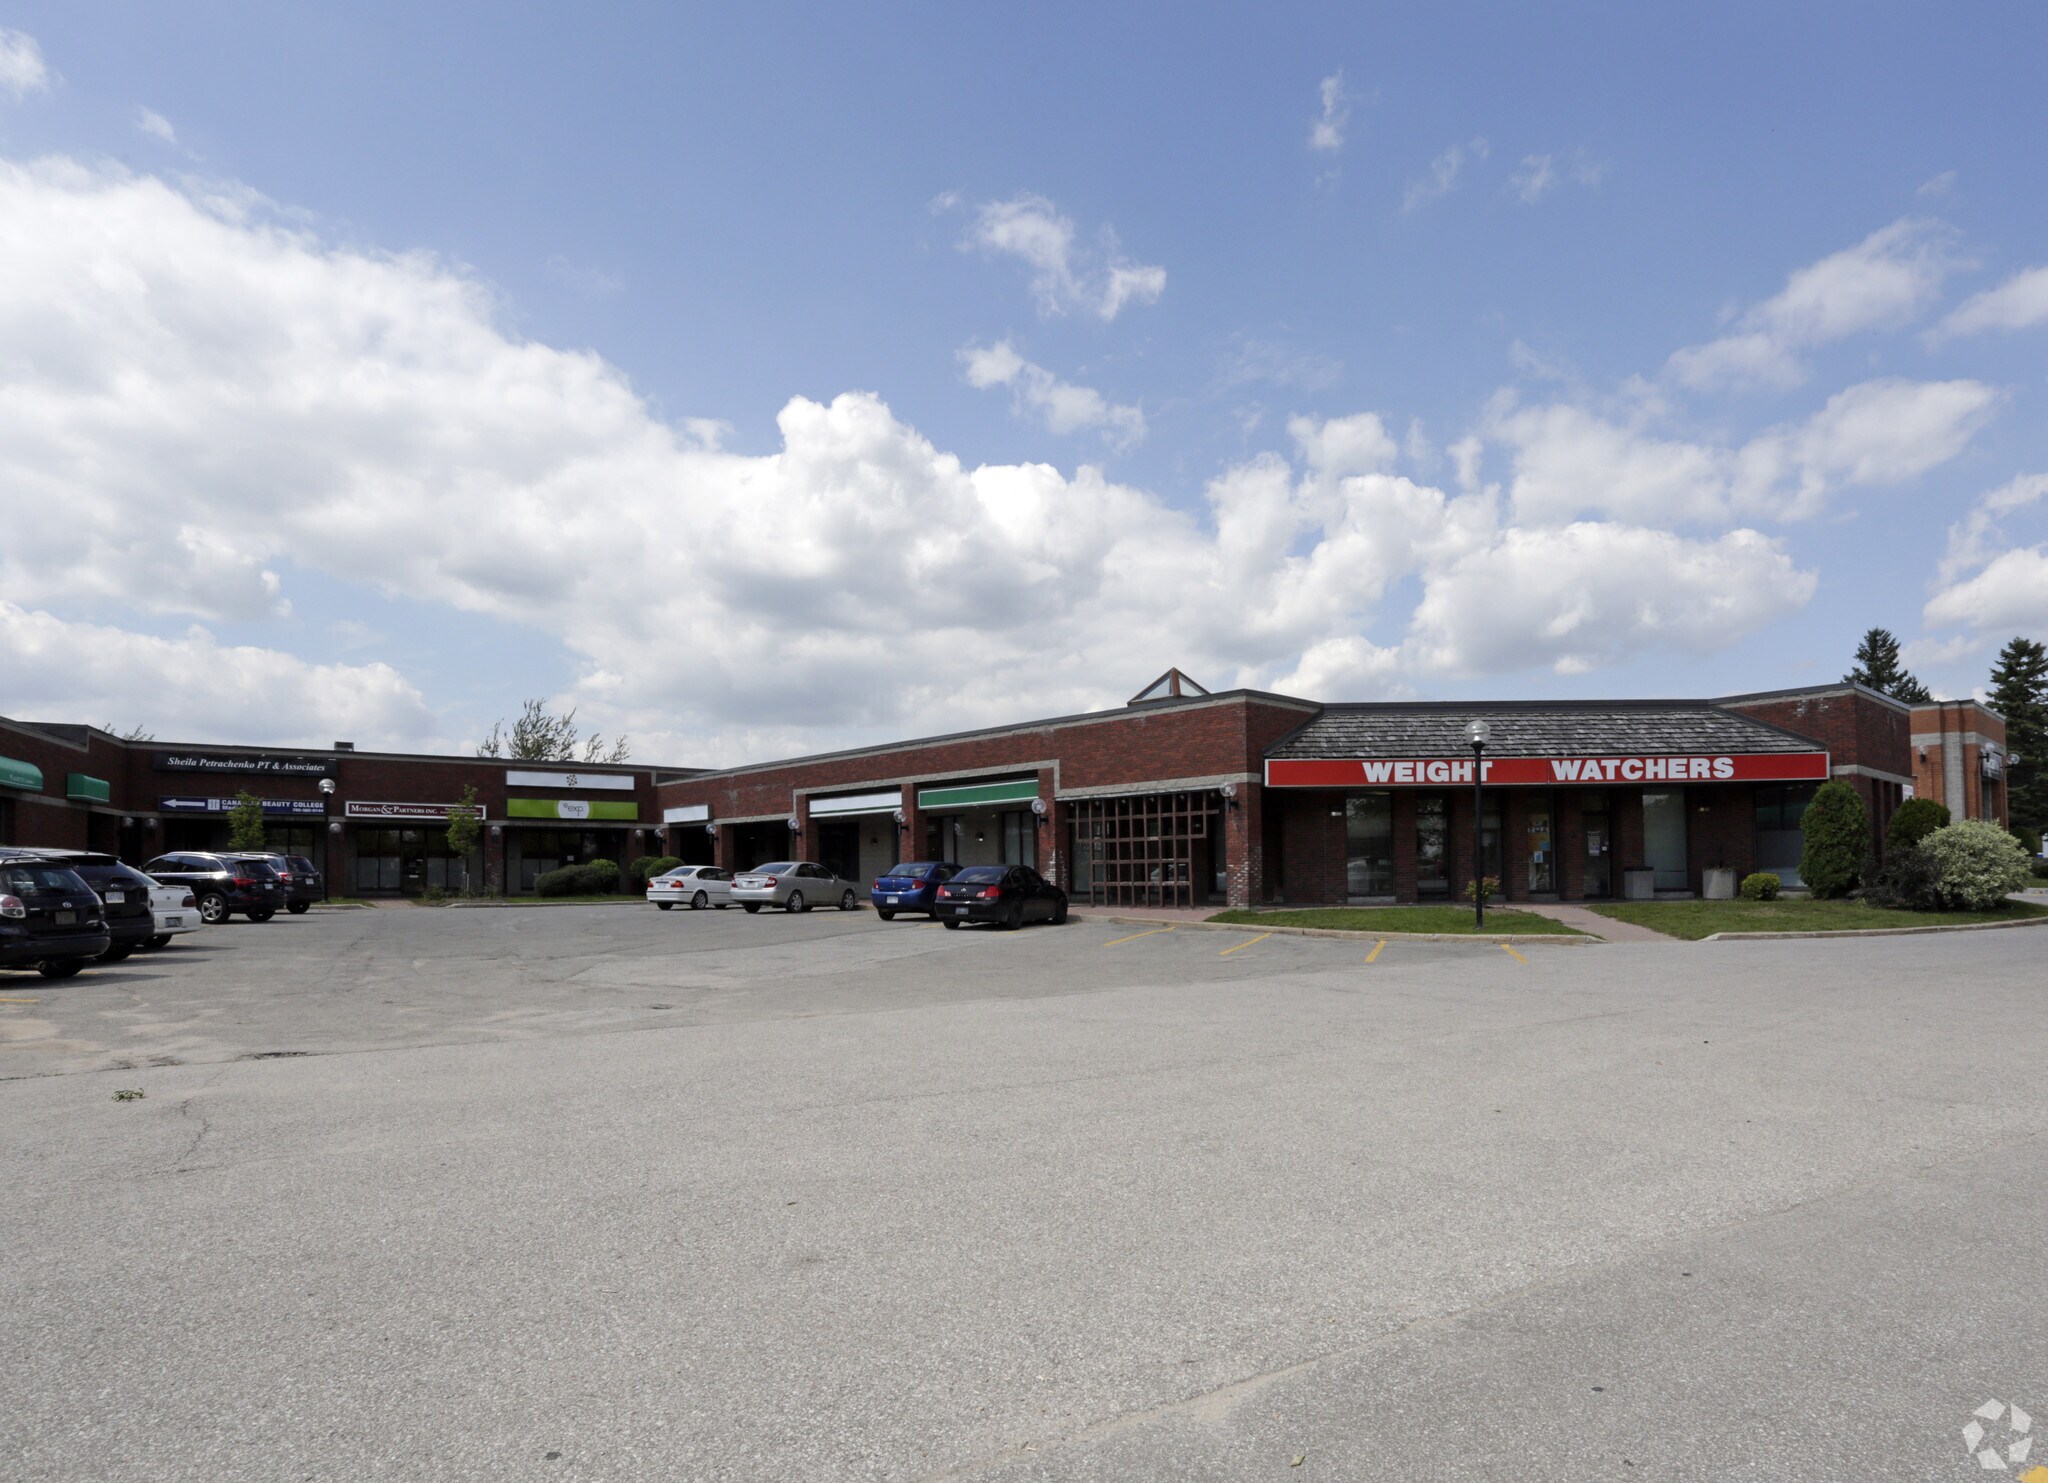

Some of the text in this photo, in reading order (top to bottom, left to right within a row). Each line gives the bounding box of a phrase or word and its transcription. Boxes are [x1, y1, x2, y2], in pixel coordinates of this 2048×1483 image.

[167, 757, 326, 772] Sheila Petrachenko PT & Associates
[1362, 757, 1735, 783] WEIGHT WATCHERS
